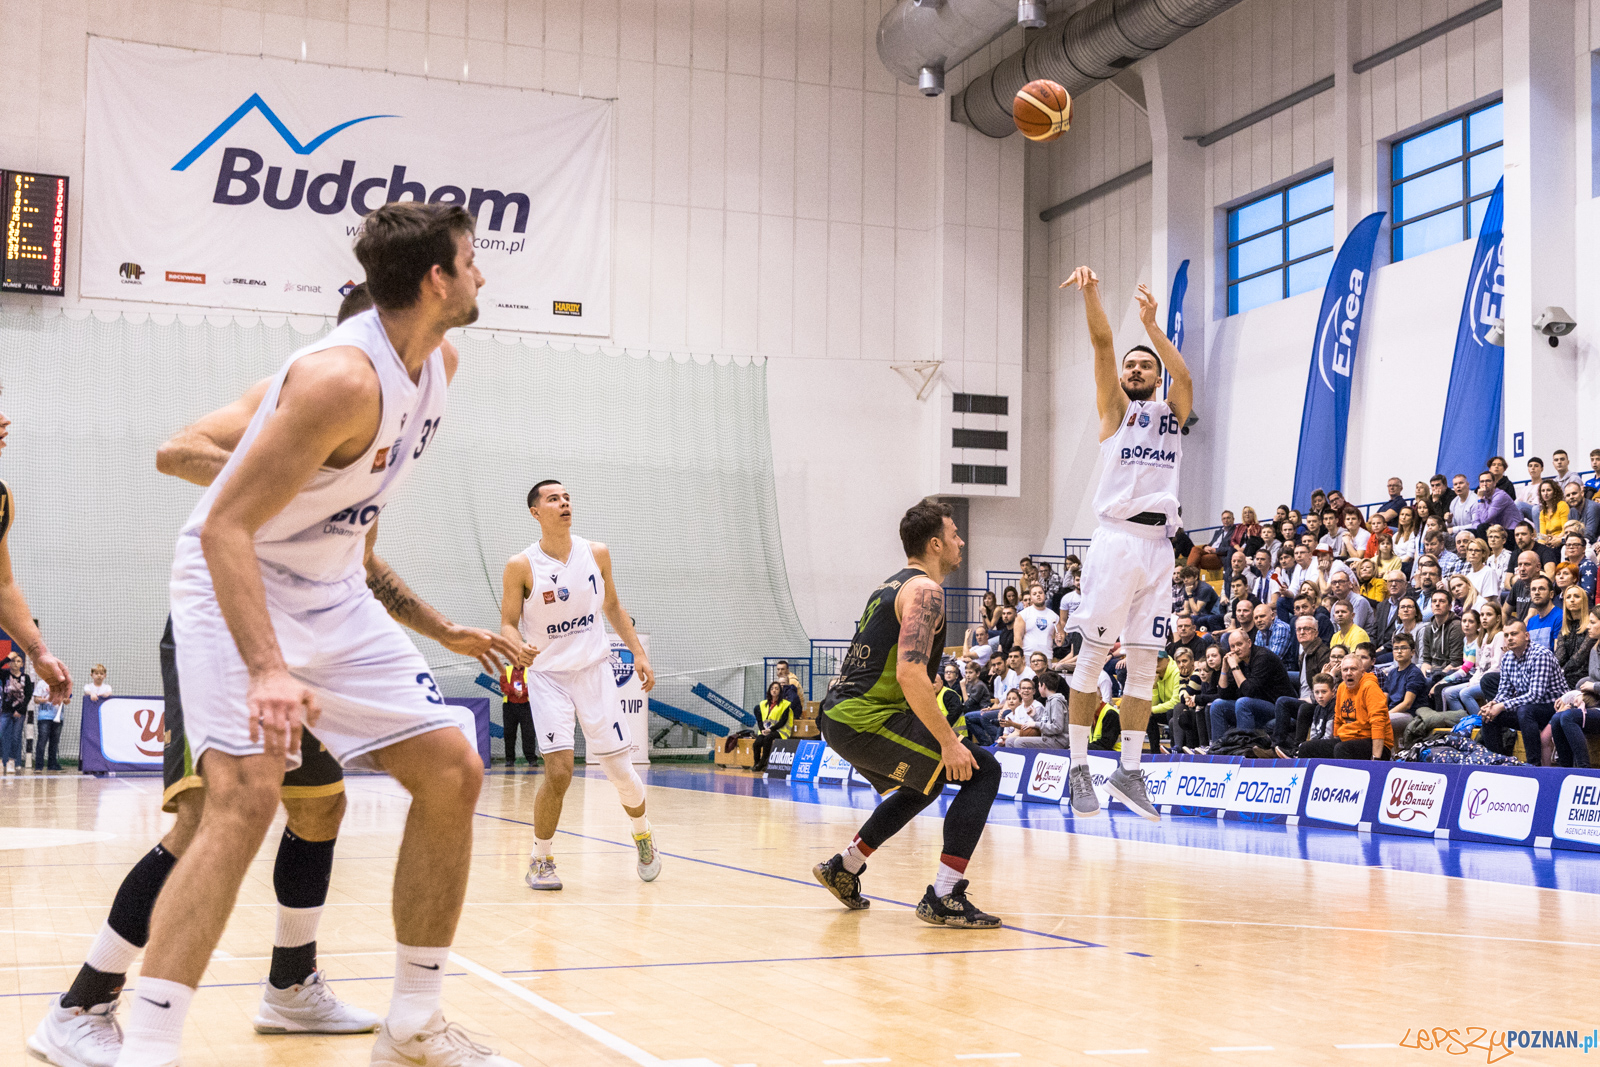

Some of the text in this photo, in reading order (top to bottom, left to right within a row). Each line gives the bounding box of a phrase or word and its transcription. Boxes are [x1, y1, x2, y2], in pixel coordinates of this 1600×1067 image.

[15, 174, 22, 183] 6
[16, 182, 22, 190] 7
[56, 194, 64, 203] 0
[12, 205, 21, 213] 10
[7, 251, 19, 260] 57
[168, 272, 203, 282] ROCKWOOL
[232, 277, 267, 287] SELENA
[296, 284, 322, 293] siniat
[554, 302, 581, 312] HARDY
[1331, 268, 1365, 378] Enea
[1159, 412, 1179, 436] 66
[412, 415, 441, 460] 31
[1515, 435, 1523, 454] C
[1120, 445, 1176, 463] BIOFARM
[588, 573, 598, 595] 1
[628, 699, 643, 714] VIP
[613, 721, 624, 742] 1
[1176, 775, 1226, 799] POZnan
[1235, 781, 1291, 805] POZnan
[1310, 787, 1361, 805] BIOFARM
[1402, 791, 1435, 809] Danuty
